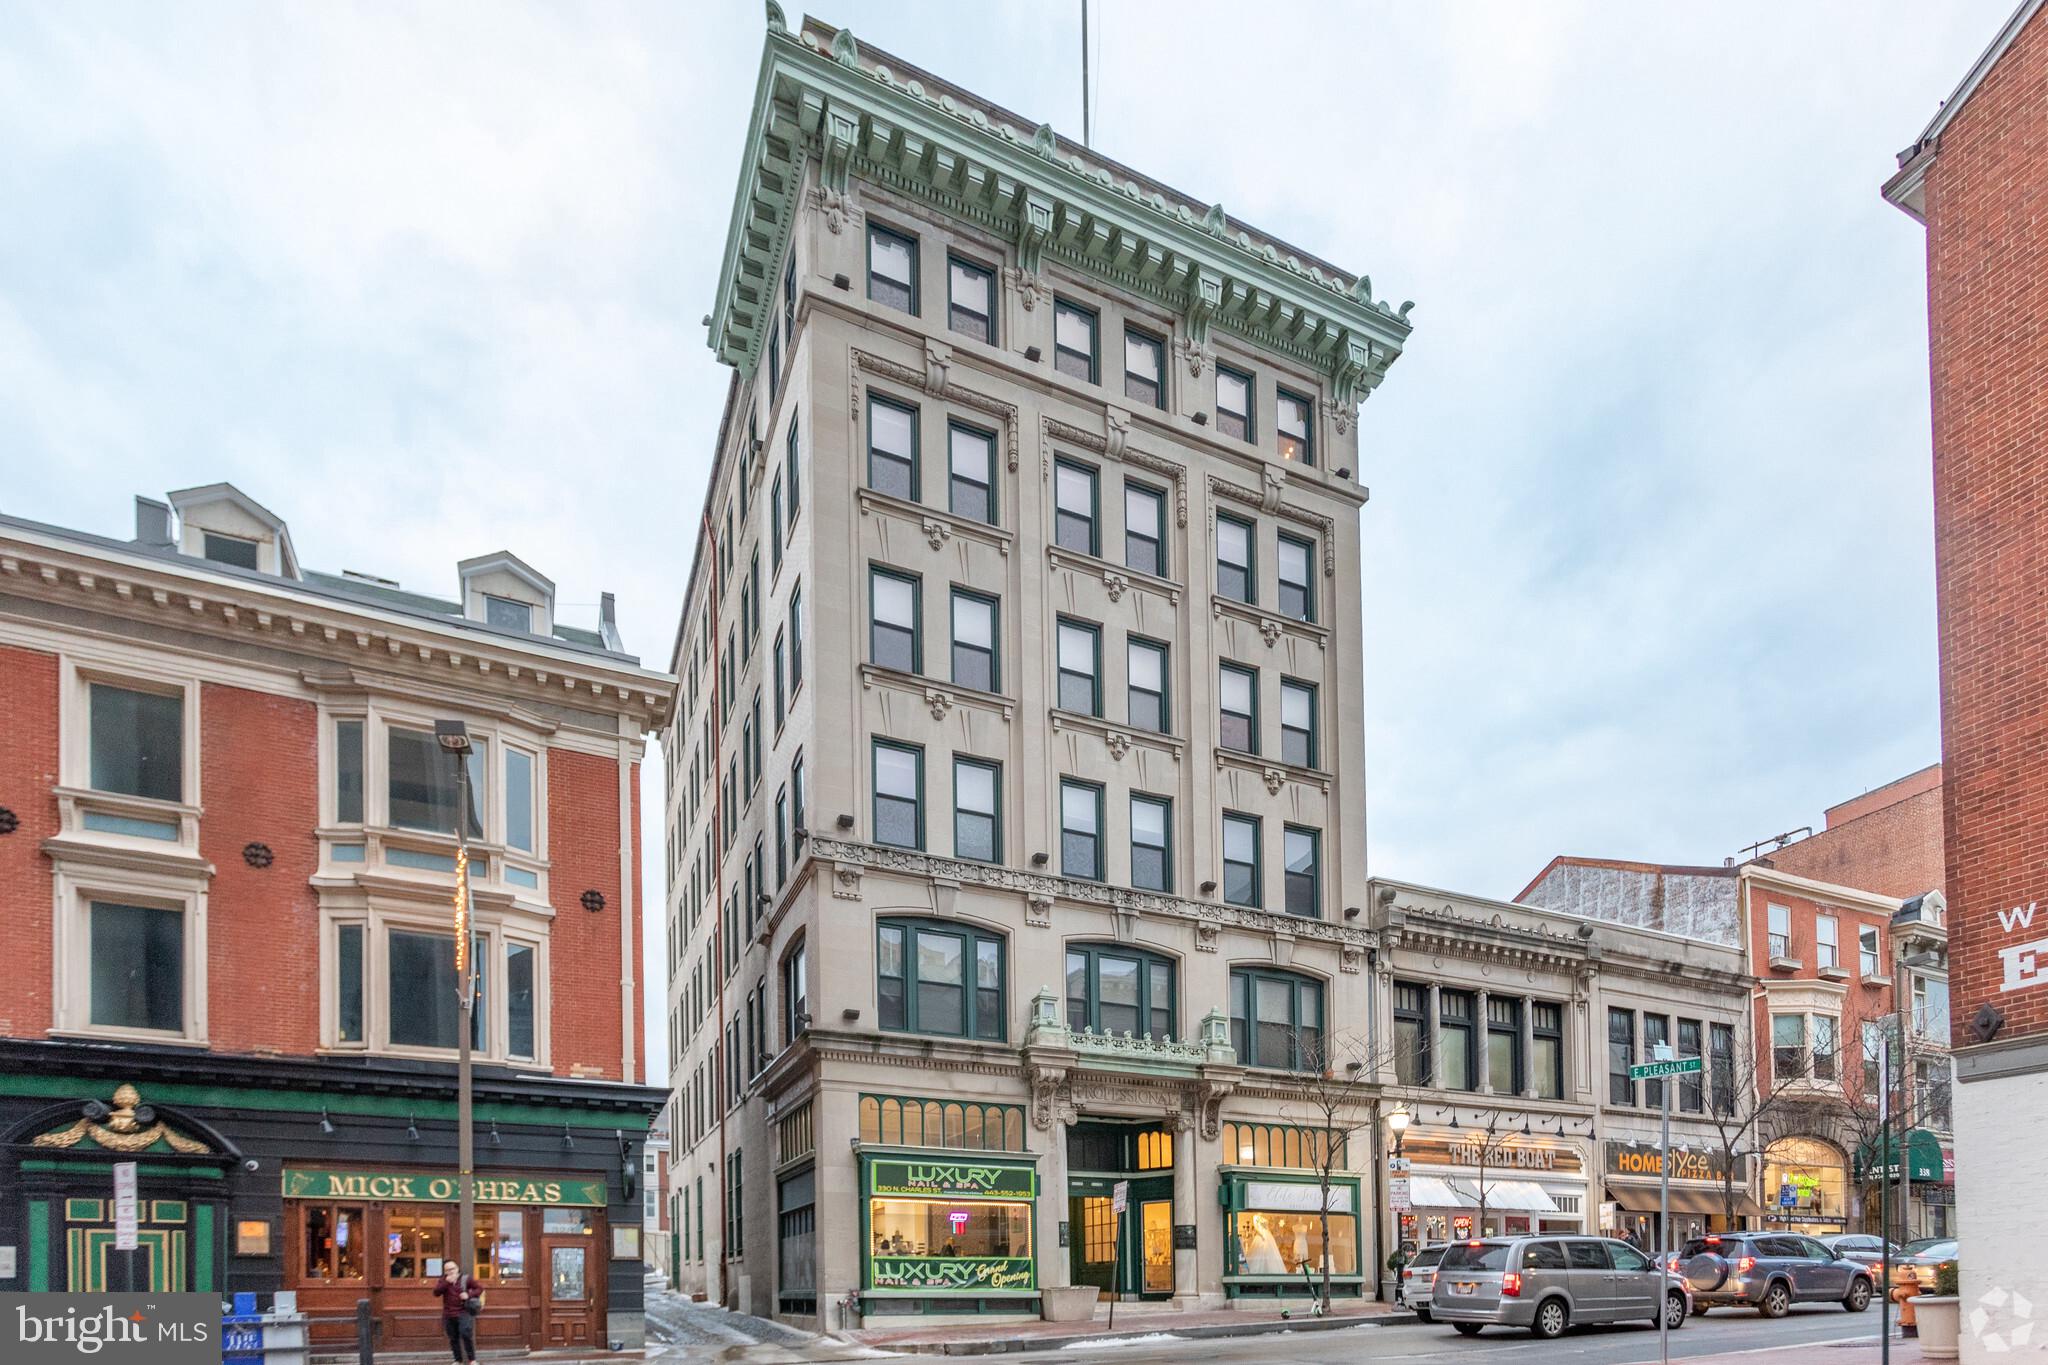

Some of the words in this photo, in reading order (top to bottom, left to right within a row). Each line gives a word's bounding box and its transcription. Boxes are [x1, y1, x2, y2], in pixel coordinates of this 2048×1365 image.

[1634, 1069, 1642, 1078] E.
[1644, 1062, 1687, 1076] PLEASANT
[1076, 1084, 1173, 1107] PROFESSIONAL
[1450, 1143, 1480, 1166] THE
[1484, 1145, 1512, 1168] RED
[1517, 1147, 1556, 1170] BOAT
[907, 1165, 1002, 1189] LUXURY
[1681, 1168, 1712, 1180] PIZZA
[1919, 1167, 1931, 1177] 338
[328, 1174, 415, 1199] MICK
[428, 1178, 562, 1203] O'HEA'S
[900, 1186, 933, 1194] CHARLES
[907, 1180, 938, 1188] NAIL
[955, 1182, 979, 1190] SPA
[1453, 1217, 1470, 1228] OPEN
[874, 1262, 976, 1284] LUXURY
[975, 1260, 1009, 1282] Grand
[874, 1277, 907, 1286] NAIL
[991, 1271, 1031, 1288] Opening
